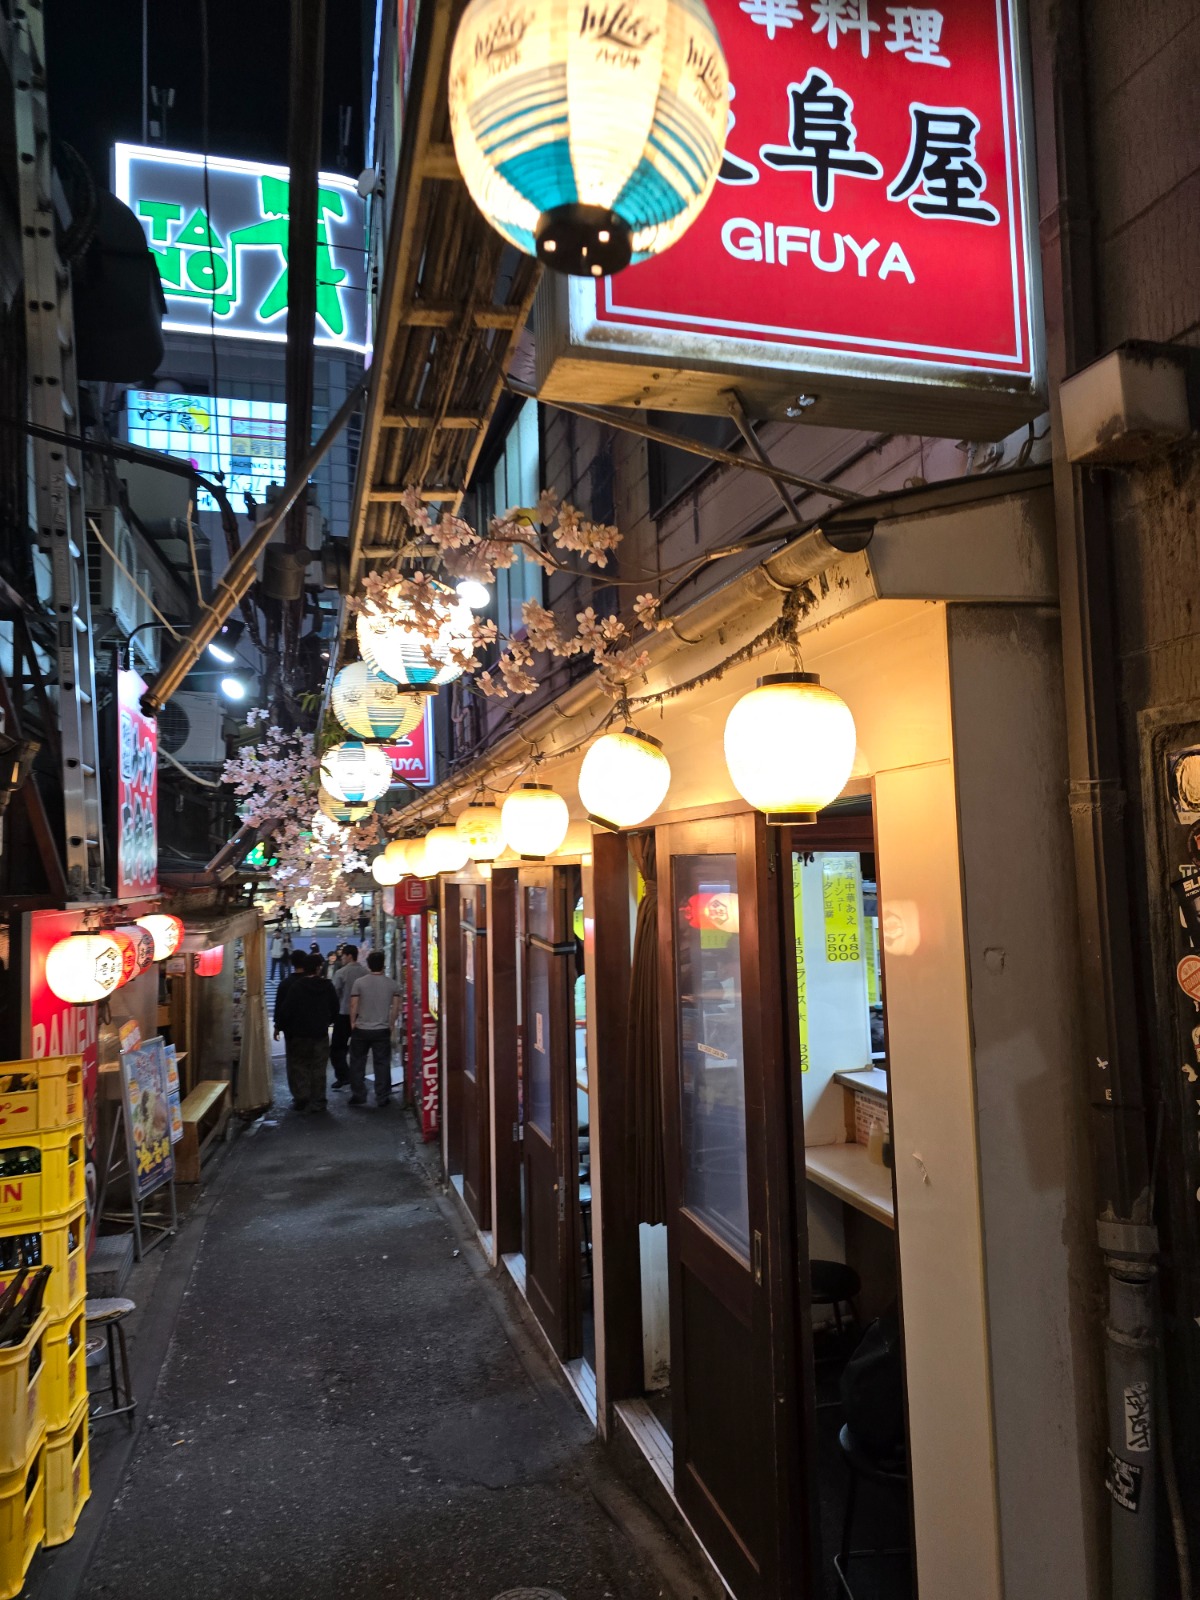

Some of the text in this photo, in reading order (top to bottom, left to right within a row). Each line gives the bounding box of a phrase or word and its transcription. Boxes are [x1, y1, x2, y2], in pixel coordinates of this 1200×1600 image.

[717, 67, 1000, 226] 阜屋
[721, 217, 915, 284] GIFUYA
[32, 1005, 97, 1059] RAMEN
